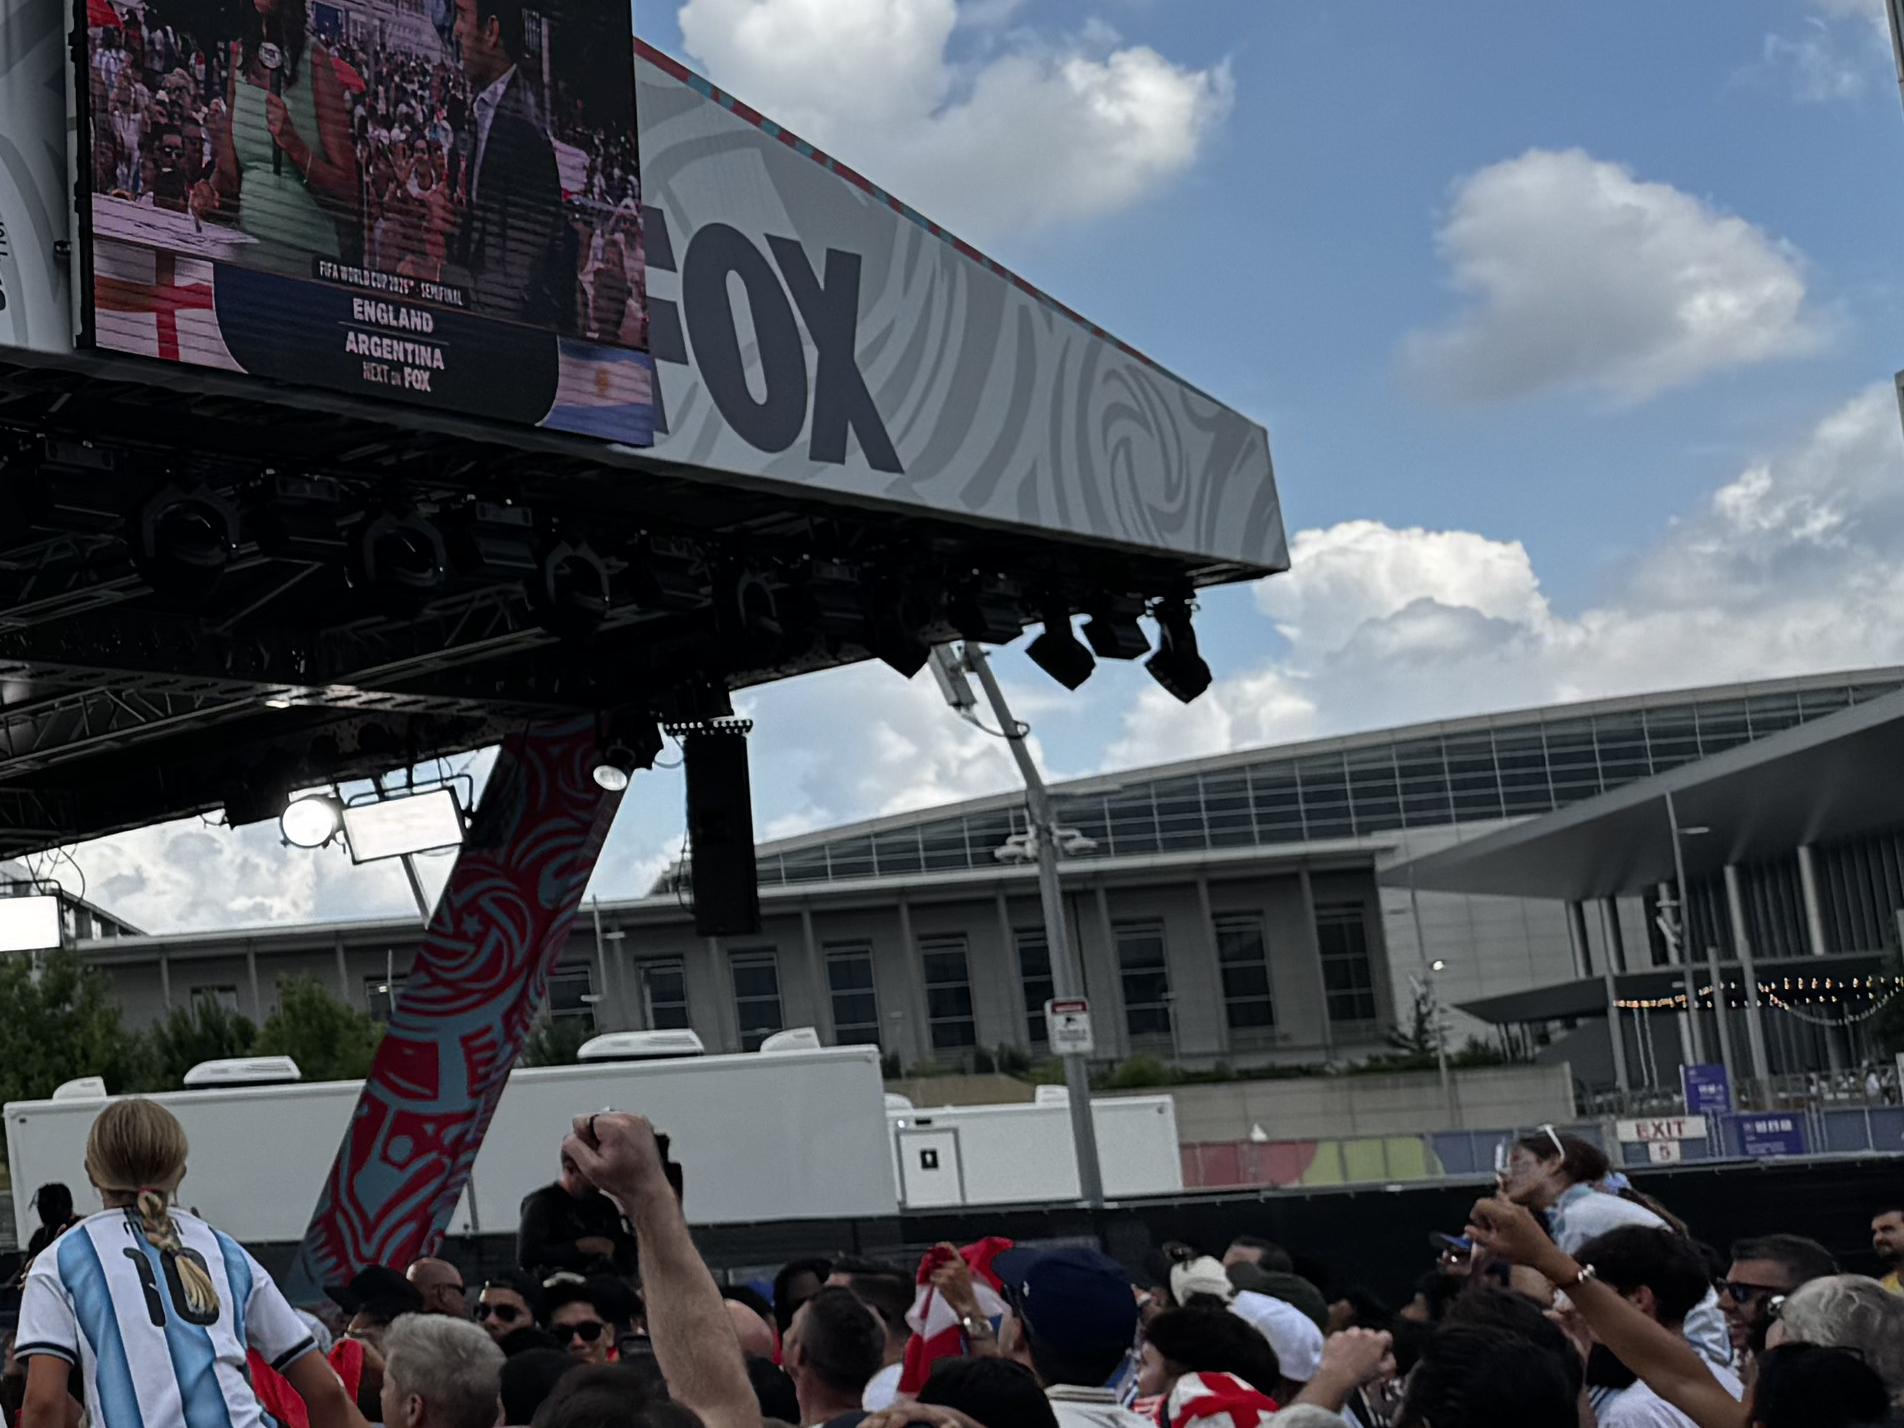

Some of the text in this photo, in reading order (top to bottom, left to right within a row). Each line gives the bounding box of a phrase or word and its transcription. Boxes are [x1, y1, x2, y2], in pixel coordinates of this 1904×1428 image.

[319, 260, 339, 280] FIFA
[340, 265, 370, 287] WORLD
[371, 270, 387, 290] CUP
[420, 282, 464, 306] SEMIFINAL
[352, 297, 434, 334] ENGLAND
[345, 331, 445, 370] ARGENTINA
[642, 205, 905, 474] FOX
[362, 361, 388, 384] NEXT
[403, 366, 431, 393] FOX
[1635, 1120, 1685, 1140] EXIT
[123, 1246, 220, 1328] 10
